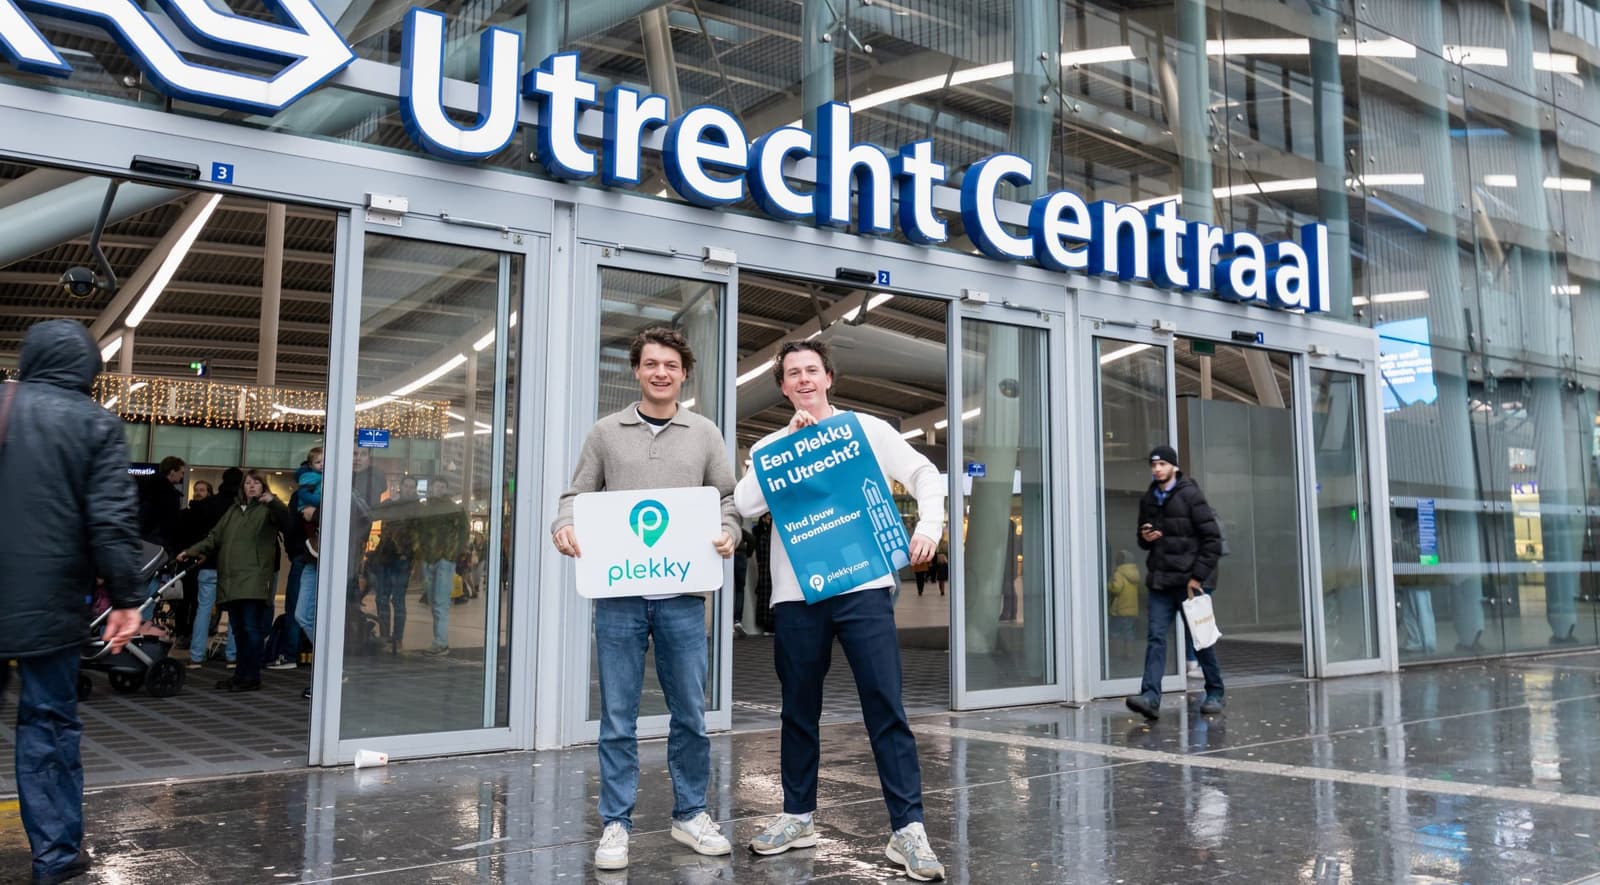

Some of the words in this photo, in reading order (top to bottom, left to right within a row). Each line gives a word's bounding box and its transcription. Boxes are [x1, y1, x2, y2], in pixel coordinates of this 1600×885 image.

[217, 166, 227, 179] 3
[402, 8, 948, 243] Utrecht
[961, 153, 1331, 314] Centraal
[881, 273, 888, 283] 2
[760, 450, 794, 471] Een
[794, 423, 852, 457] Plekky
[128, 467, 156, 476] ormatie
[767, 477, 787, 492] in
[787, 441, 860, 483] Utrecht?
[784, 516, 809, 532] Vind
[808, 507, 834, 525] jouw
[790, 510, 861, 544] droomkantoor
[608, 556, 690, 587] plekky
[827, 560, 870, 583] plekky.com
